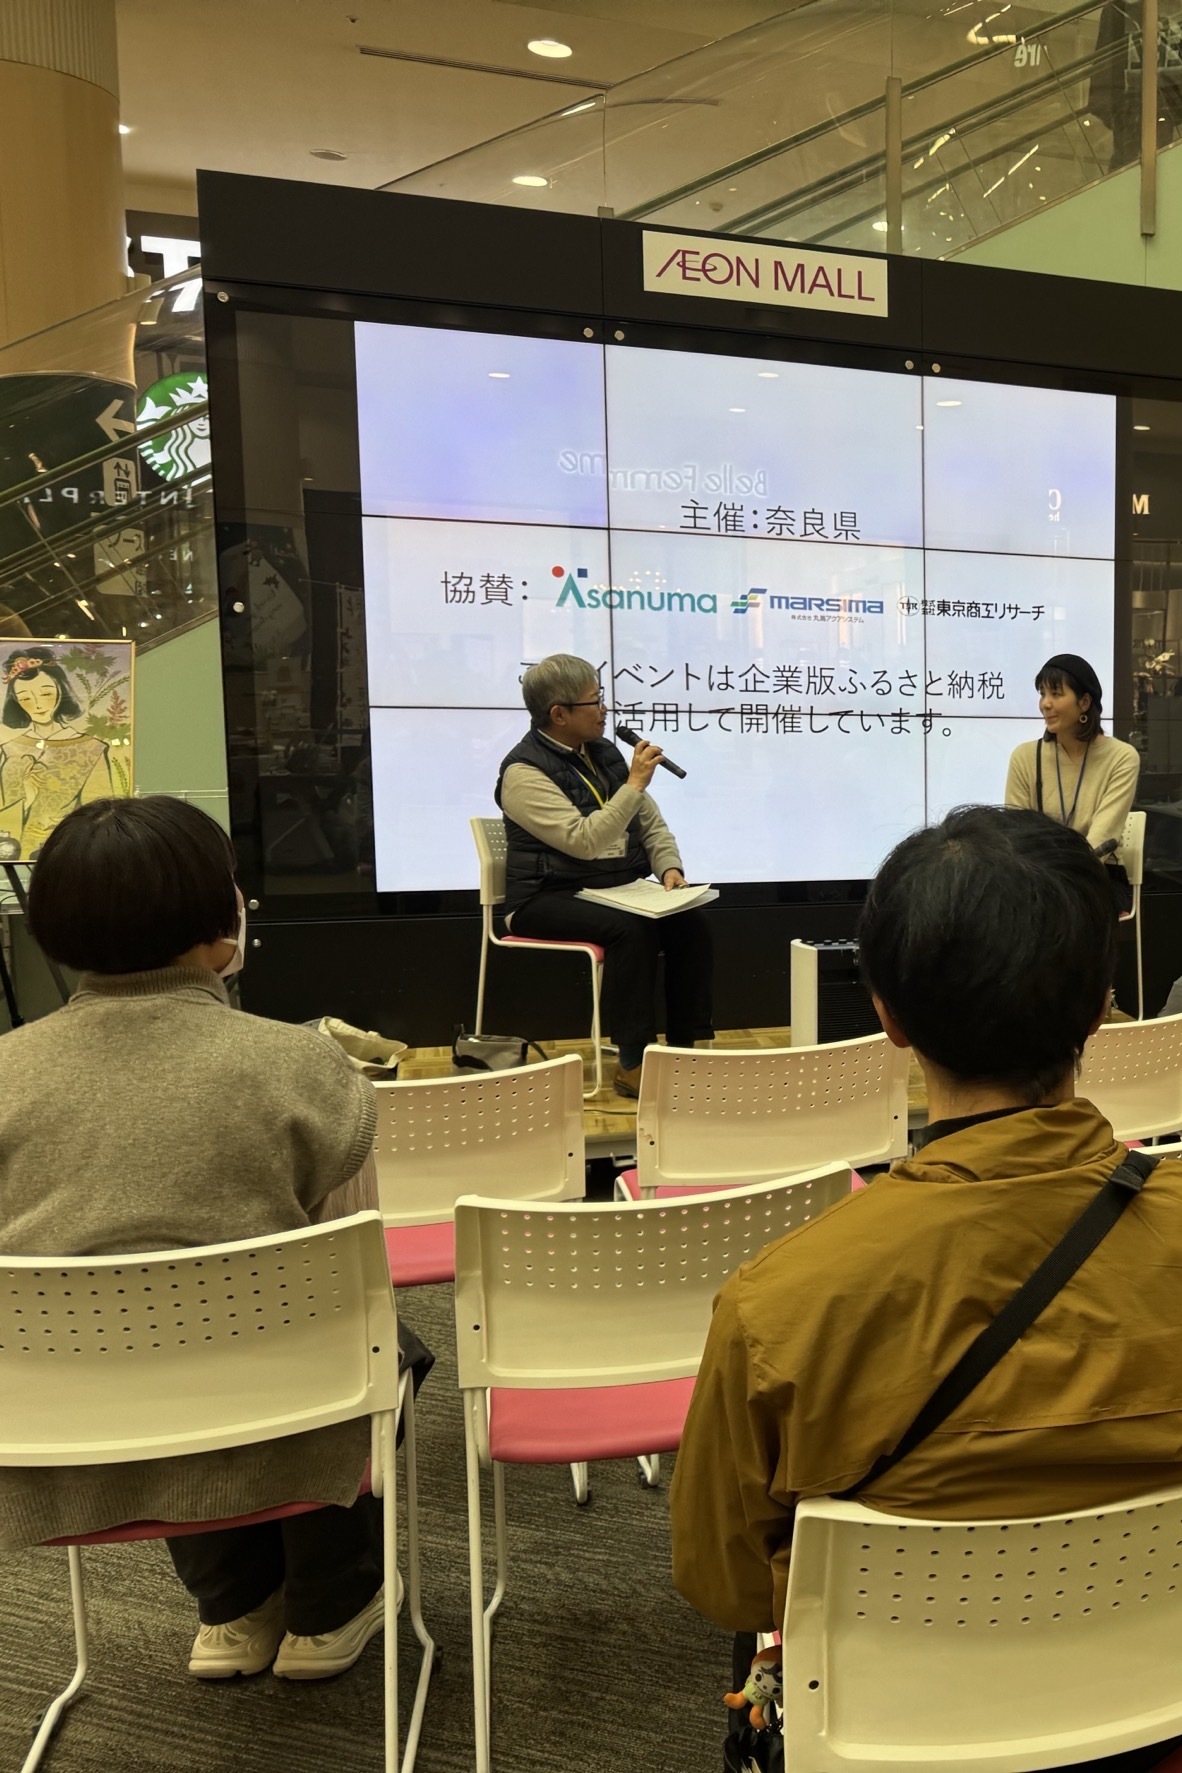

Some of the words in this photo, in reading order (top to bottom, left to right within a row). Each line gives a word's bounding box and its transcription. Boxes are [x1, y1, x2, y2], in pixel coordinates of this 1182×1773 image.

[773, 260, 876, 302] MALL
[680, 499, 862, 541] 主催：奈良県
[441, 571, 528, 607] 協賛：
[555, 570, 718, 613] Asanuma
[936, 599, 1045, 621] 東京商工リサーチ
